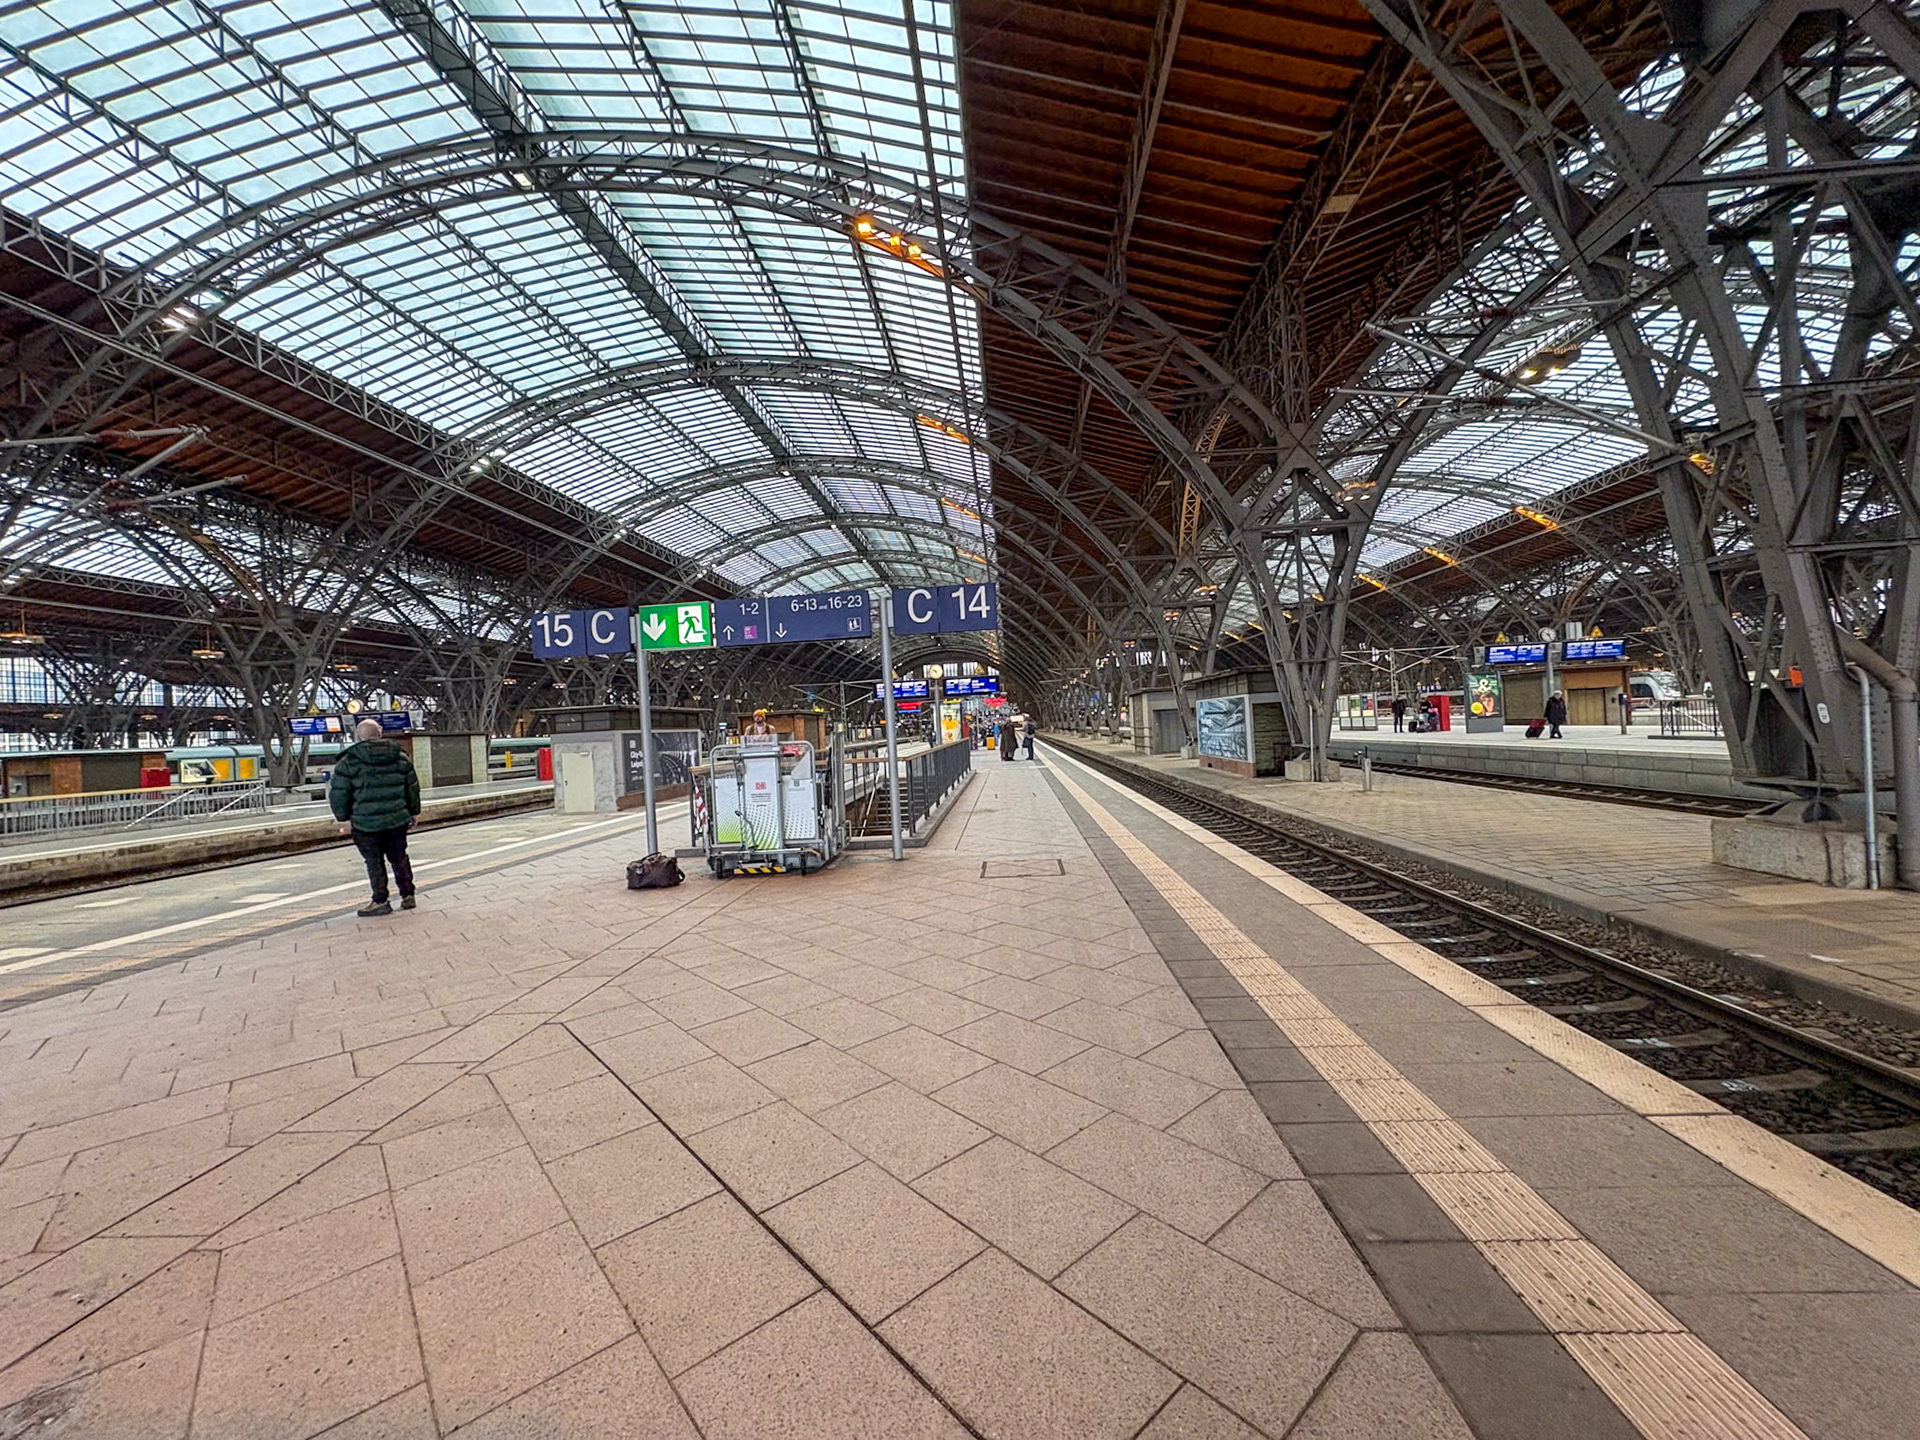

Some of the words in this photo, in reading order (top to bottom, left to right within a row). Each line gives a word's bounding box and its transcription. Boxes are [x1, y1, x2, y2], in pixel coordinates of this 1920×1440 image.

[739, 603, 759, 615] 1-2
[790, 600, 817, 612] 6-13
[828, 595, 863, 609] 16-23
[907, 588, 933, 624] C
[951, 585, 991, 620] 14
[536, 613, 574, 648] 15
[591, 610, 616, 645] C
